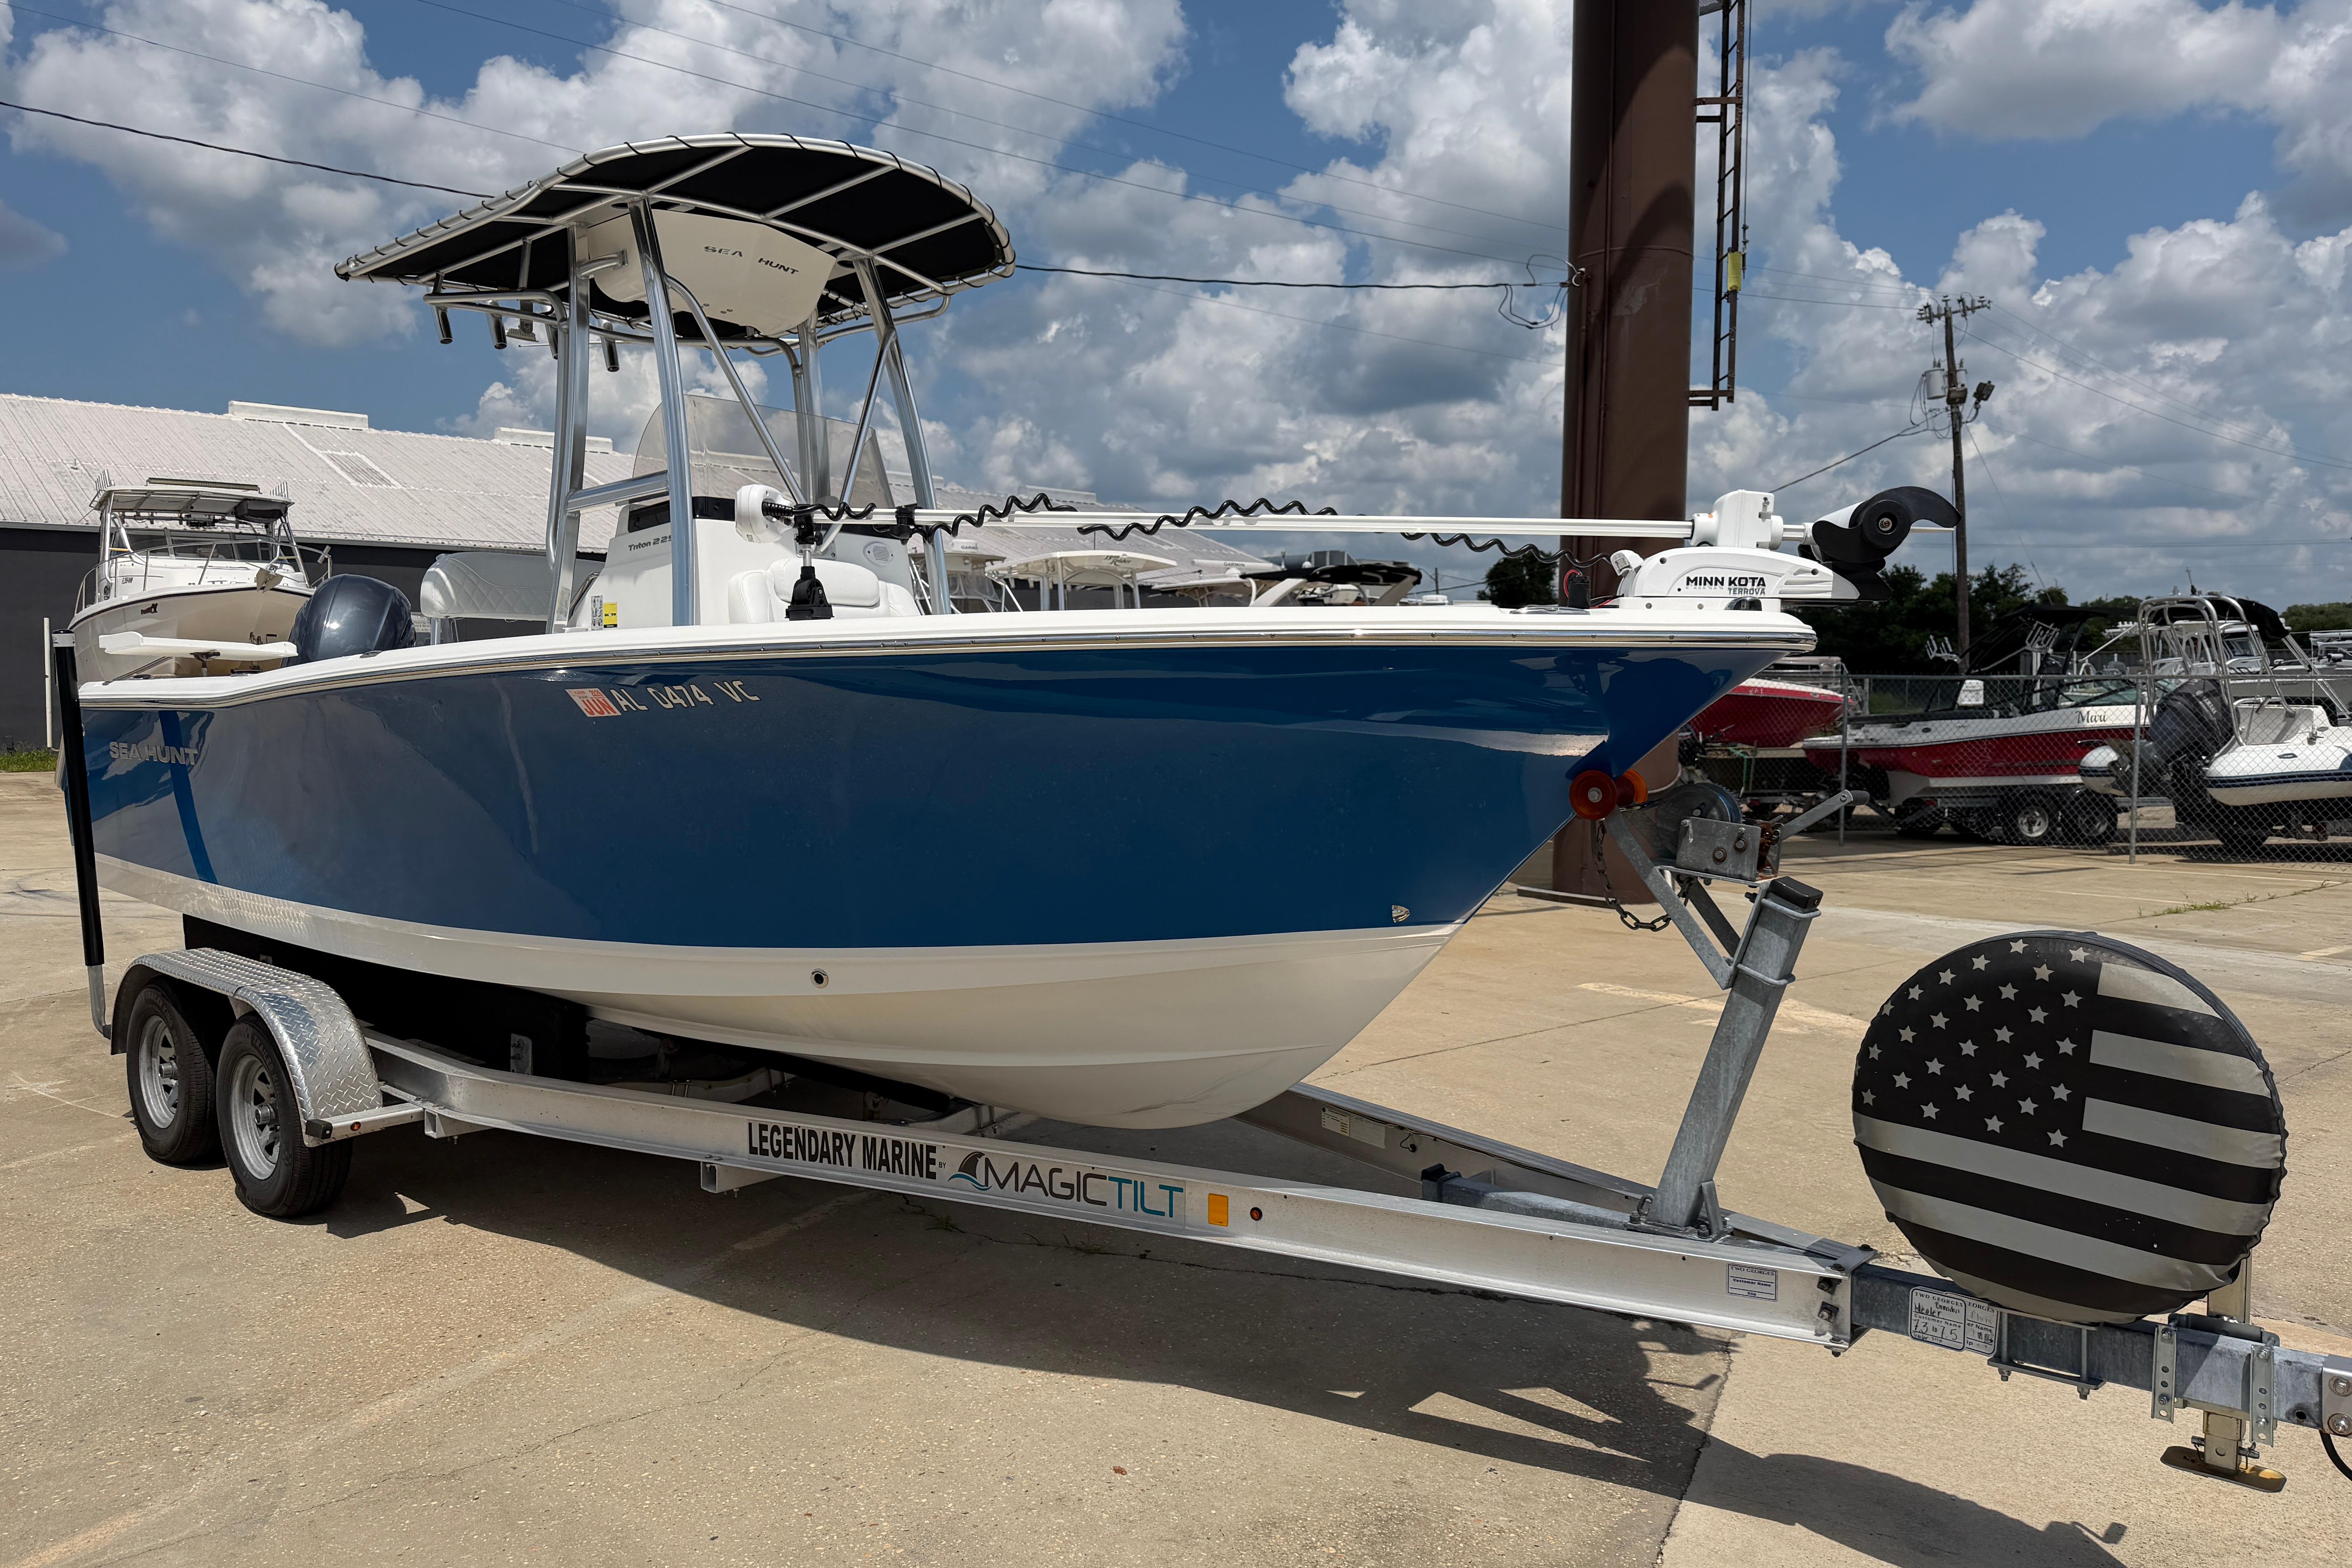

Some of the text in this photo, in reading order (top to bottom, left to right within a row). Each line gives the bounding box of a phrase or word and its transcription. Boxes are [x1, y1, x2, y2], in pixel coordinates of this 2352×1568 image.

[703, 246, 799, 275] SEA HUNT
[628, 541, 651, 551] Triton
[1686, 576, 1766, 587] MINN KOTA
[610, 680, 761, 711] AL 0474 VC
[2202, 695, 2217, 714] YAMAHA
[581, 699, 617, 716] JUN
[109, 742, 199, 765] SEA HUNT
[253, 1035, 274, 1071] TRAILER
[748, 1122, 856, 1167] LEGENDARY
[862, 1136, 937, 1180] MARINE
[1932, 1296, 1963, 1307] GEORGES
[1914, 1314, 1942, 1323] Customer
[1975, 1323, 1993, 1334] Name
